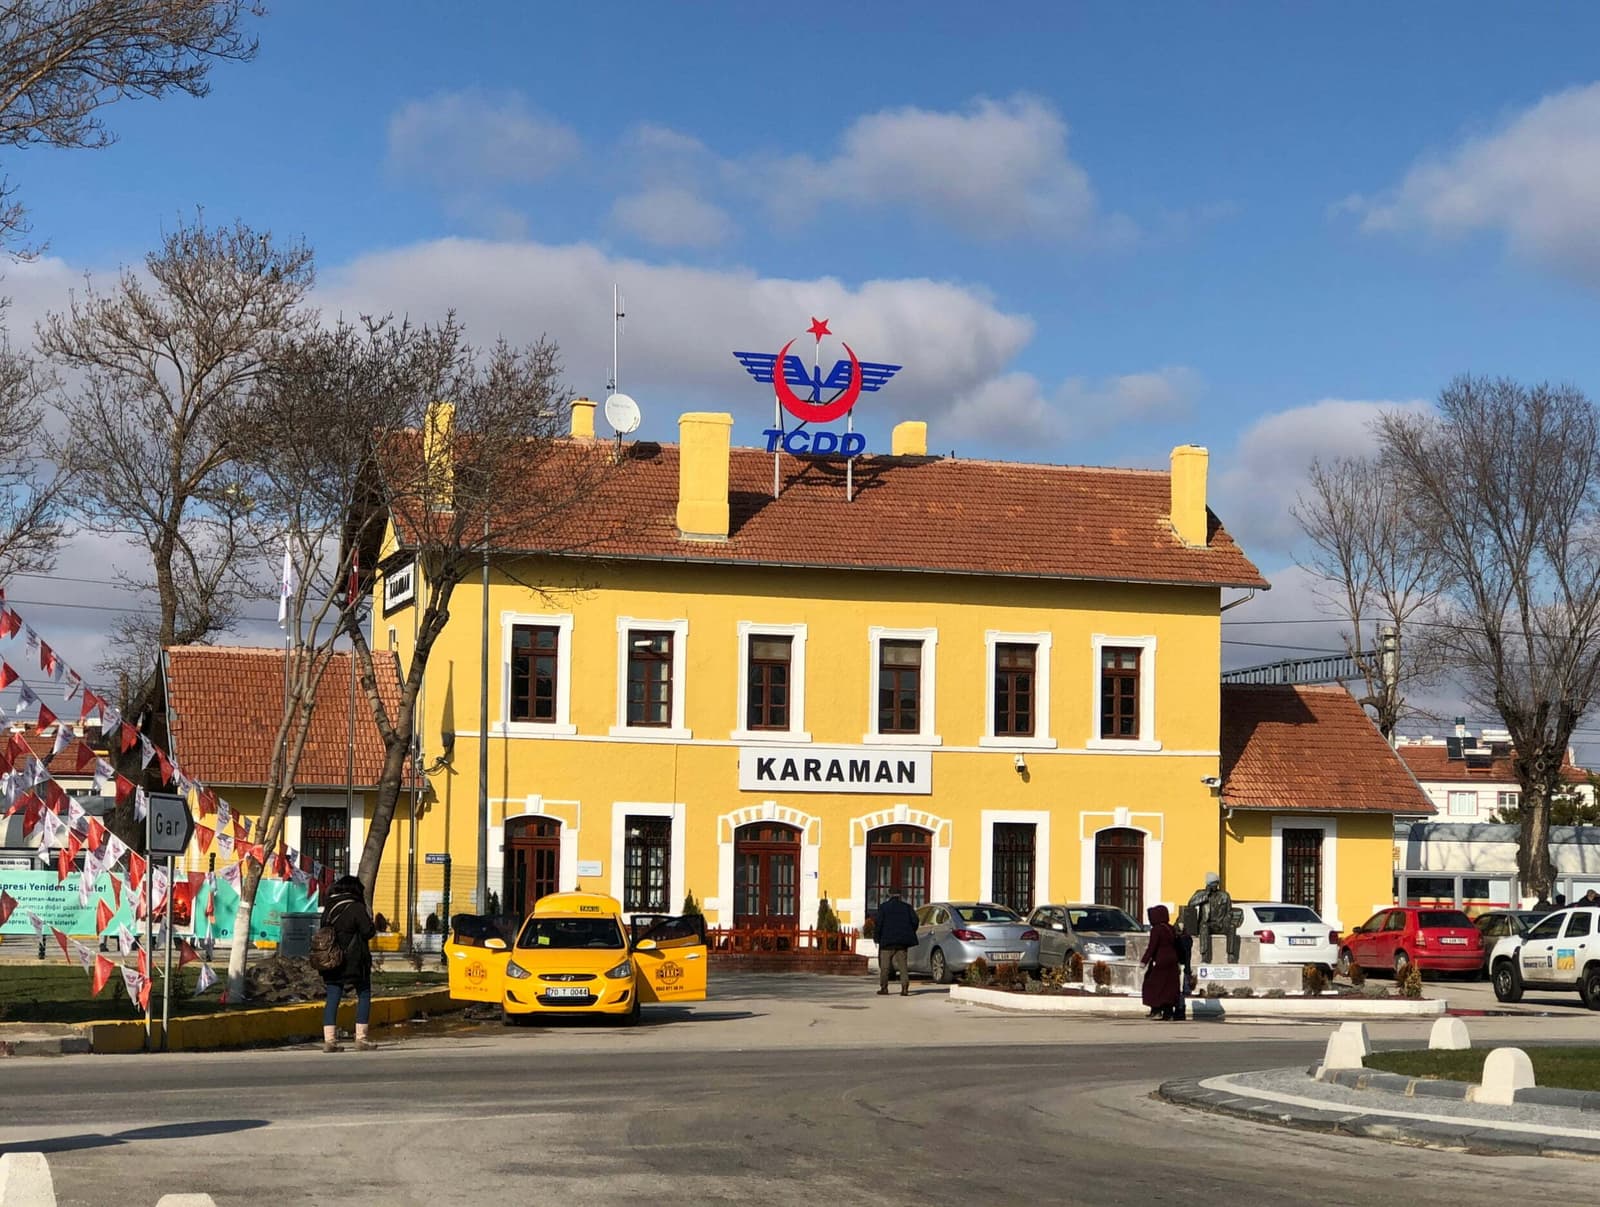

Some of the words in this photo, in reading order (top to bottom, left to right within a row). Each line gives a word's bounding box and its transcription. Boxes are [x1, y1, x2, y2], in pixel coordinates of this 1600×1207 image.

[762, 429, 866, 457] TCDD
[756, 757, 916, 784] KARAMAN
[155, 812, 180, 836] Gar
[29, 883, 66, 892] Yeniden
